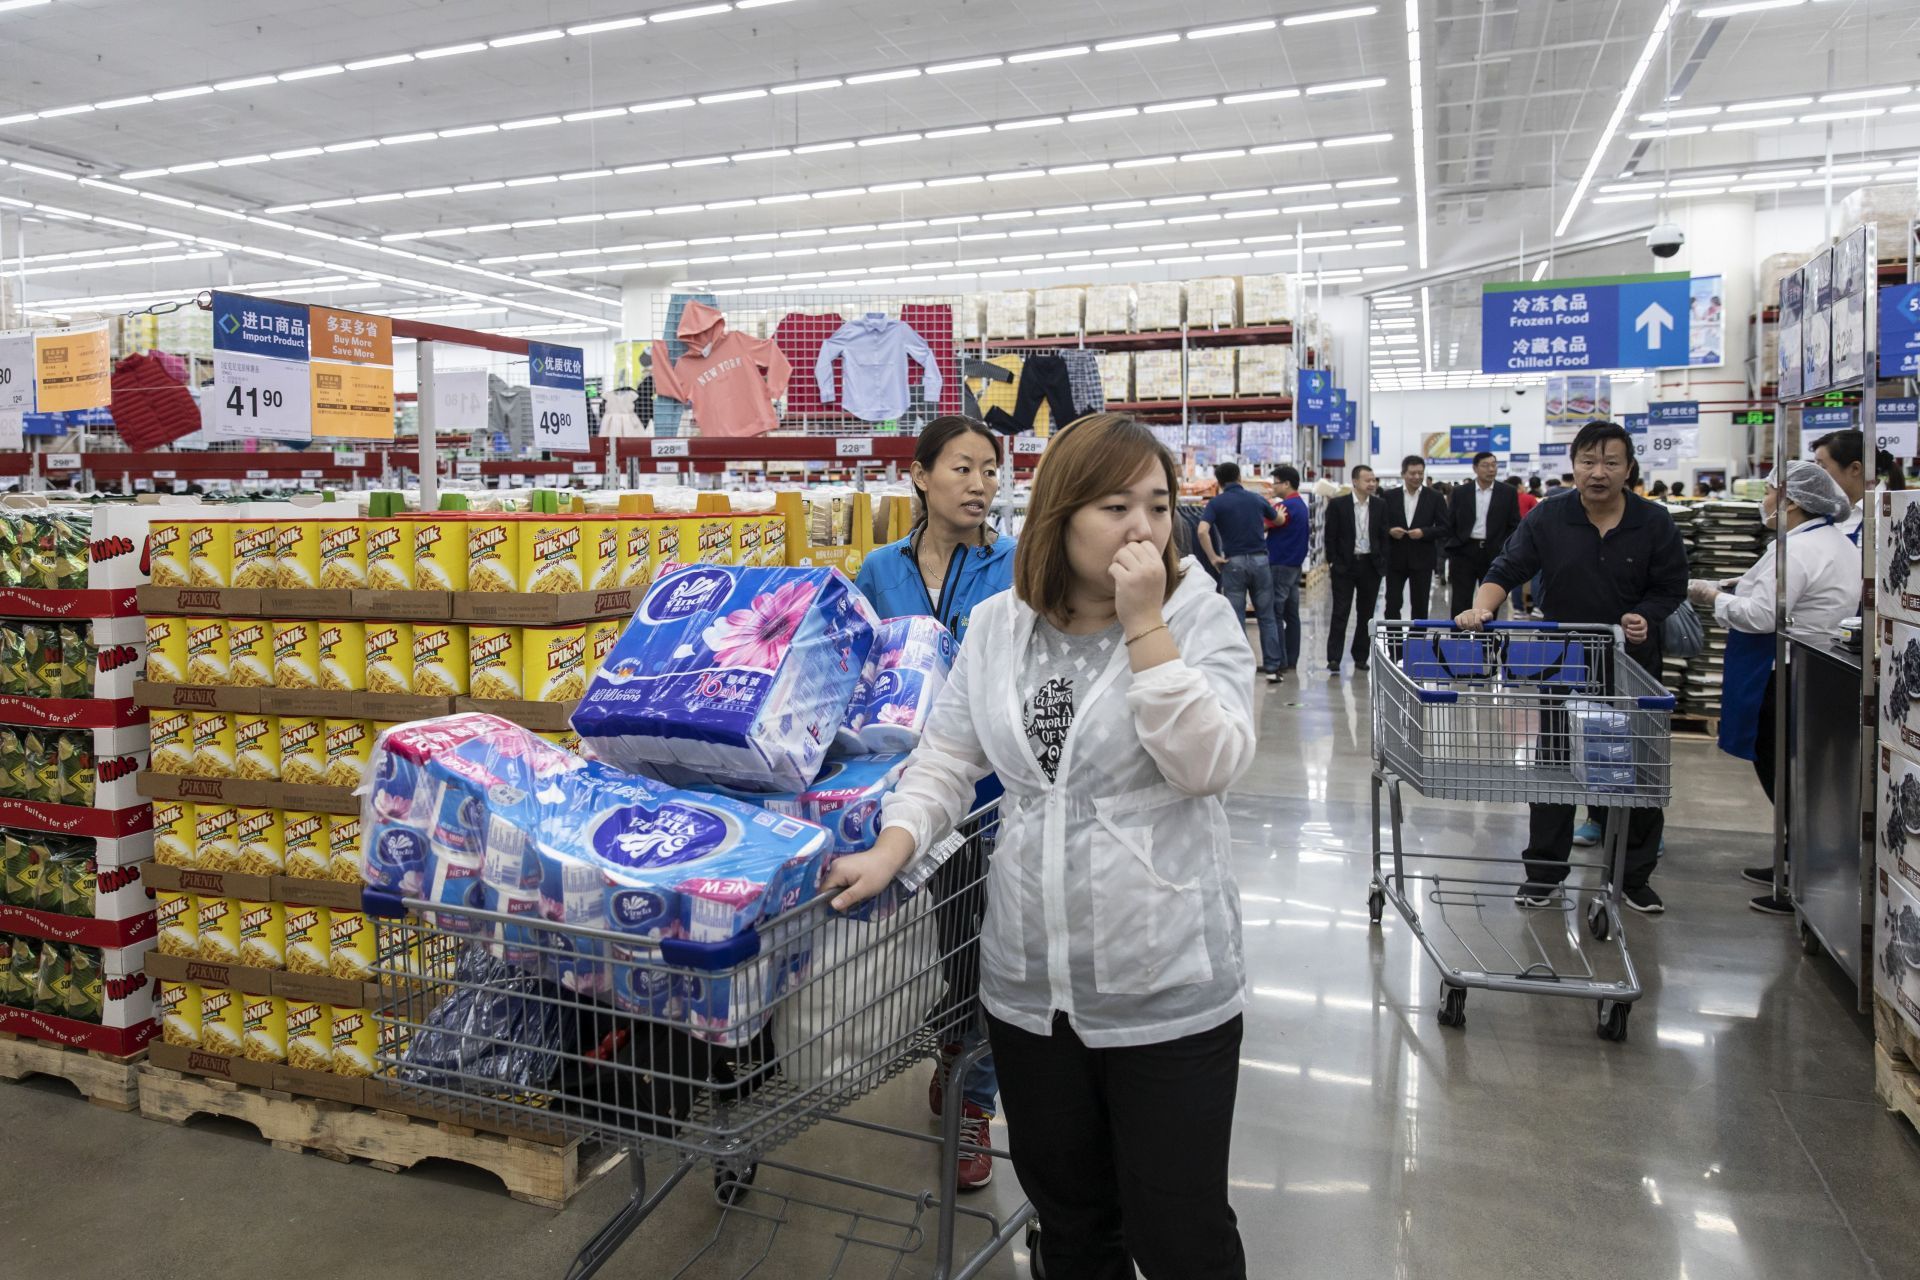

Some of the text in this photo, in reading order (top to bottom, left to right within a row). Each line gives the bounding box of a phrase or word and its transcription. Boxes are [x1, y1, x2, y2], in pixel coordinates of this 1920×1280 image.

[1512, 293, 1588, 314] 冷冻食品
[242, 310, 305, 337] 进口商品
[327, 315, 379, 337] 多买多省
[1509, 312, 1590, 328] Frozen Food
[243, 332, 305, 348] Import Product
[334, 334, 373, 348] Buy More
[1512, 335, 1587, 356] 冷藏食品
[332, 345, 375, 359] Save More
[545, 356, 582, 374] 优质优价
[1507, 354, 1590, 369] Chilled Food
[697, 357, 743, 387] NEW YORK
[546, 547, 572, 560] ORIGINAL
[17, 592, 41, 609] sulten
[43, 603, 54, 613] for
[475, 652, 500, 666] ORIGINAL
[45, 668, 61, 678] SOUR
[617, 691, 642, 702] Strong
[22, 701, 46, 719] sulten
[49, 712, 61, 723] for
[1047, 704, 1073, 717] IN A
[1042, 731, 1056, 743] OF
[821, 801, 839, 812] NEW
[24, 804, 47, 823] sulten
[49, 817, 61, 829] for
[127, 810, 143, 827] Når
[449, 869, 471, 878] NEW
[700, 880, 752, 896] NEW
[511, 902, 533, 912] NEW
[26, 913, 49, 932] sulten
[51, 926, 63, 937] for
[31, 1016, 54, 1035] sulten
[56, 1031, 68, 1042] for
